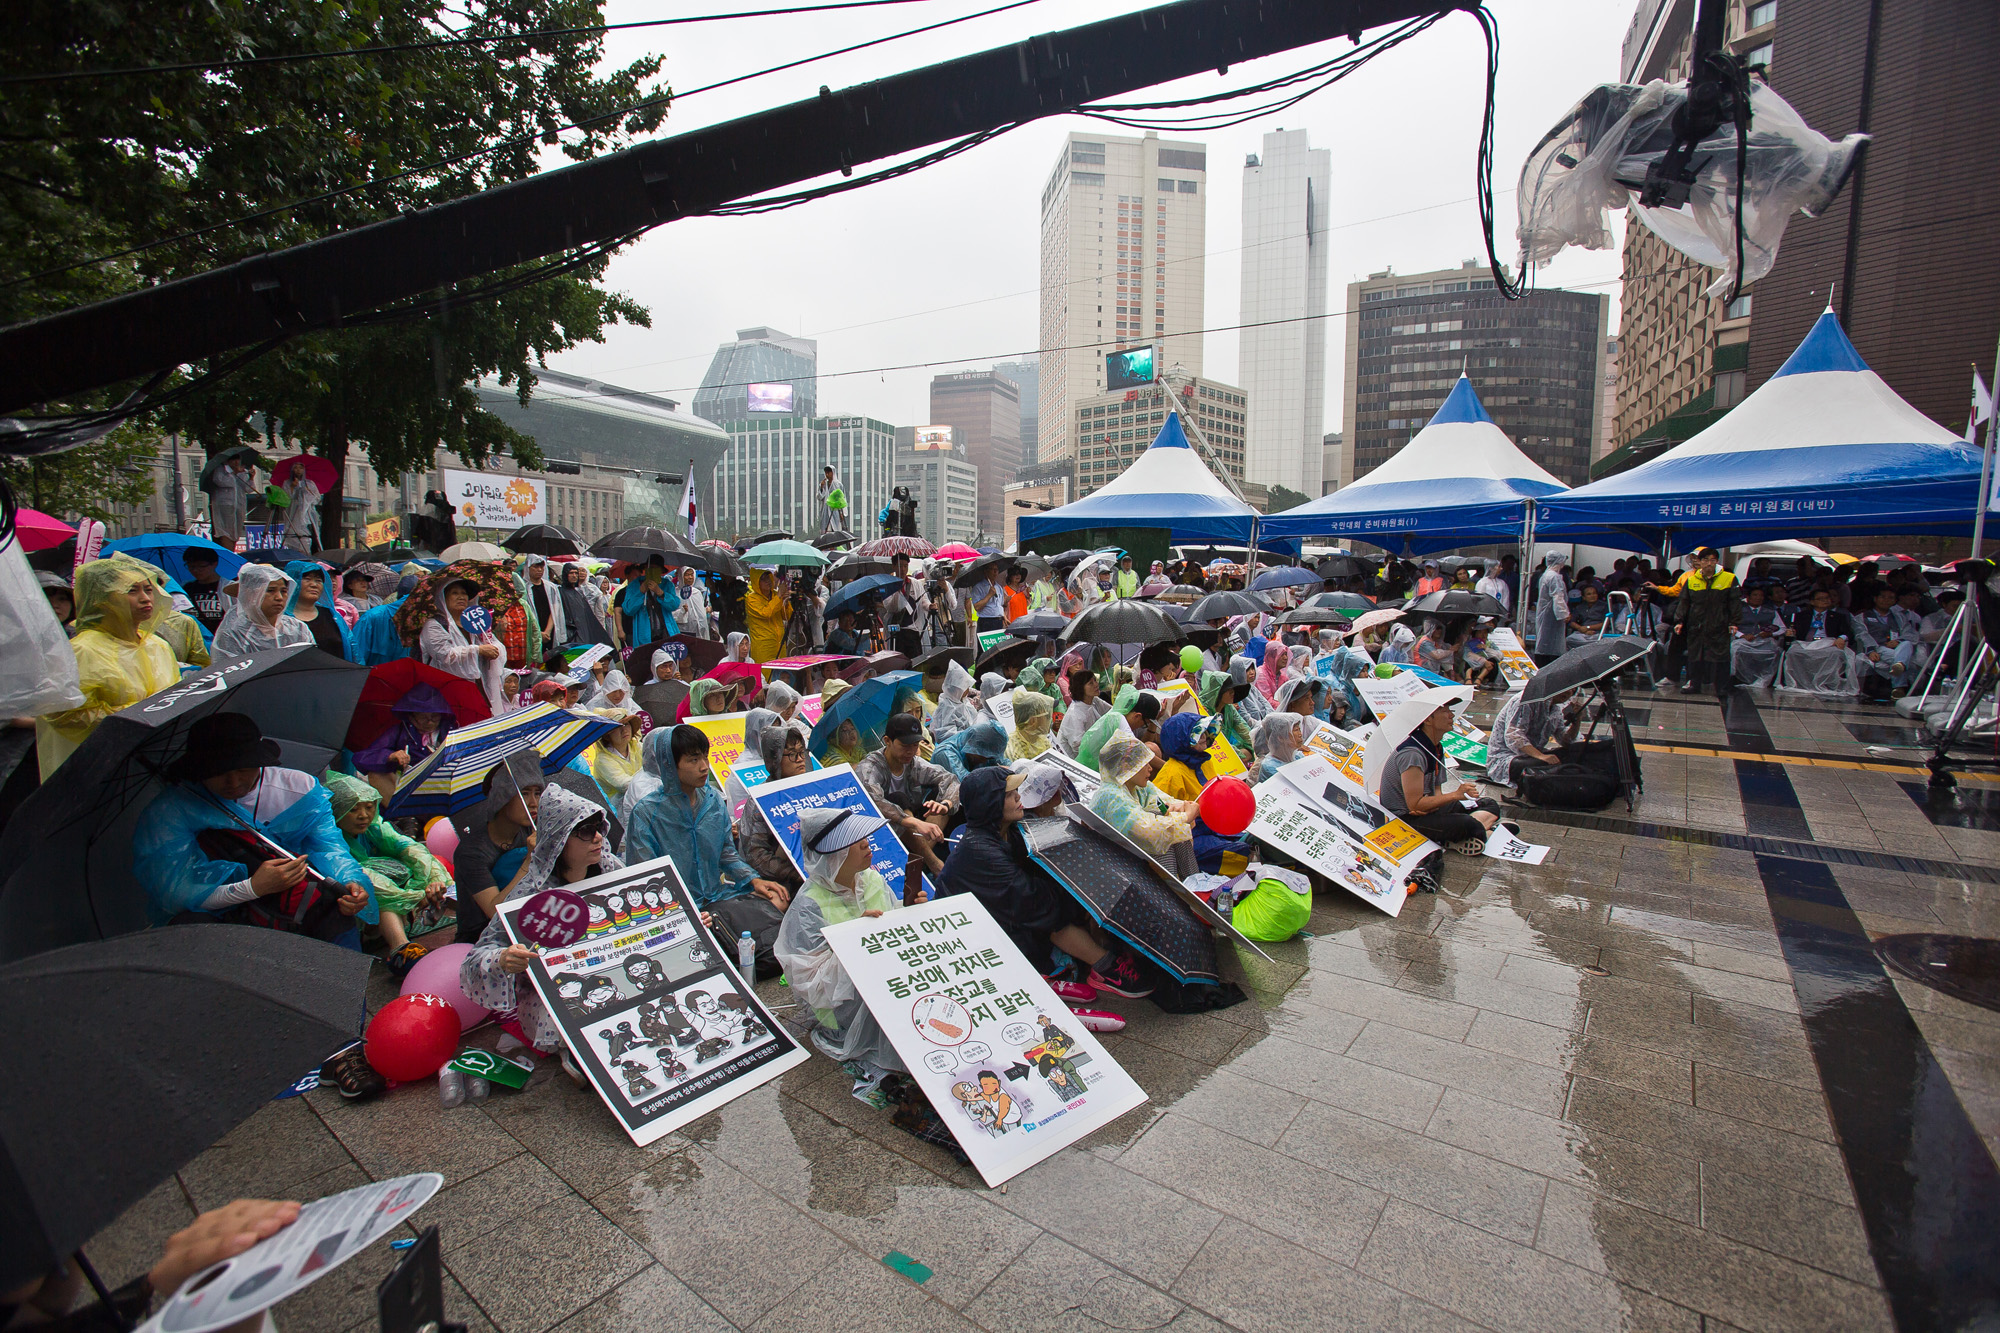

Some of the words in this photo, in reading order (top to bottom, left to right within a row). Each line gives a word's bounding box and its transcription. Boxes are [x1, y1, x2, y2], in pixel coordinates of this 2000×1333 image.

[1123, 389, 1139, 401] JEI
[461, 483, 504, 500] 고마워요
[509, 487, 534, 505] 해님
[1541, 507, 1550, 520] 2
[1658, 503, 1712, 517] 국민대회
[1719, 499, 1835, 516] 준비위원회(내빈)
[1331, 520, 1361, 530] 국민대회
[1364, 517, 1418, 529] 준비위원회(1)
[462, 607, 485, 622] YES
[662, 644, 676, 652] YES
[143, 659, 254, 712] Callaway
[1142, 672, 1152, 681] NO
[642, 715, 652, 728] NO
[743, 769, 768, 784] 우리
[769, 793, 829, 818] 차별금지법이
[828, 786, 859, 802] 통과되면?
[540, 894, 581, 924] NO
[620, 930, 649, 945] 동성애자의
[861, 924, 921, 954] 설정법
[920, 911, 973, 934] 어기고
[565, 960, 586, 972] 그들도
[606, 945, 633, 959] 보장해야
[631, 941, 644, 951] 되는
[897, 937, 967, 967] 병영에서
[887, 964, 950, 999] 동성애
[949, 948, 1003, 975] 저지른
[942, 978, 998, 1005] 장교를
[994, 988, 1035, 1017] 말라
[640, 1089, 683, 1116] 동성애자에게
[681, 1069, 726, 1096] 성추행(성폭행)
[724, 1062, 738, 1074] 당한
[736, 1053, 756, 1068] 이들의
